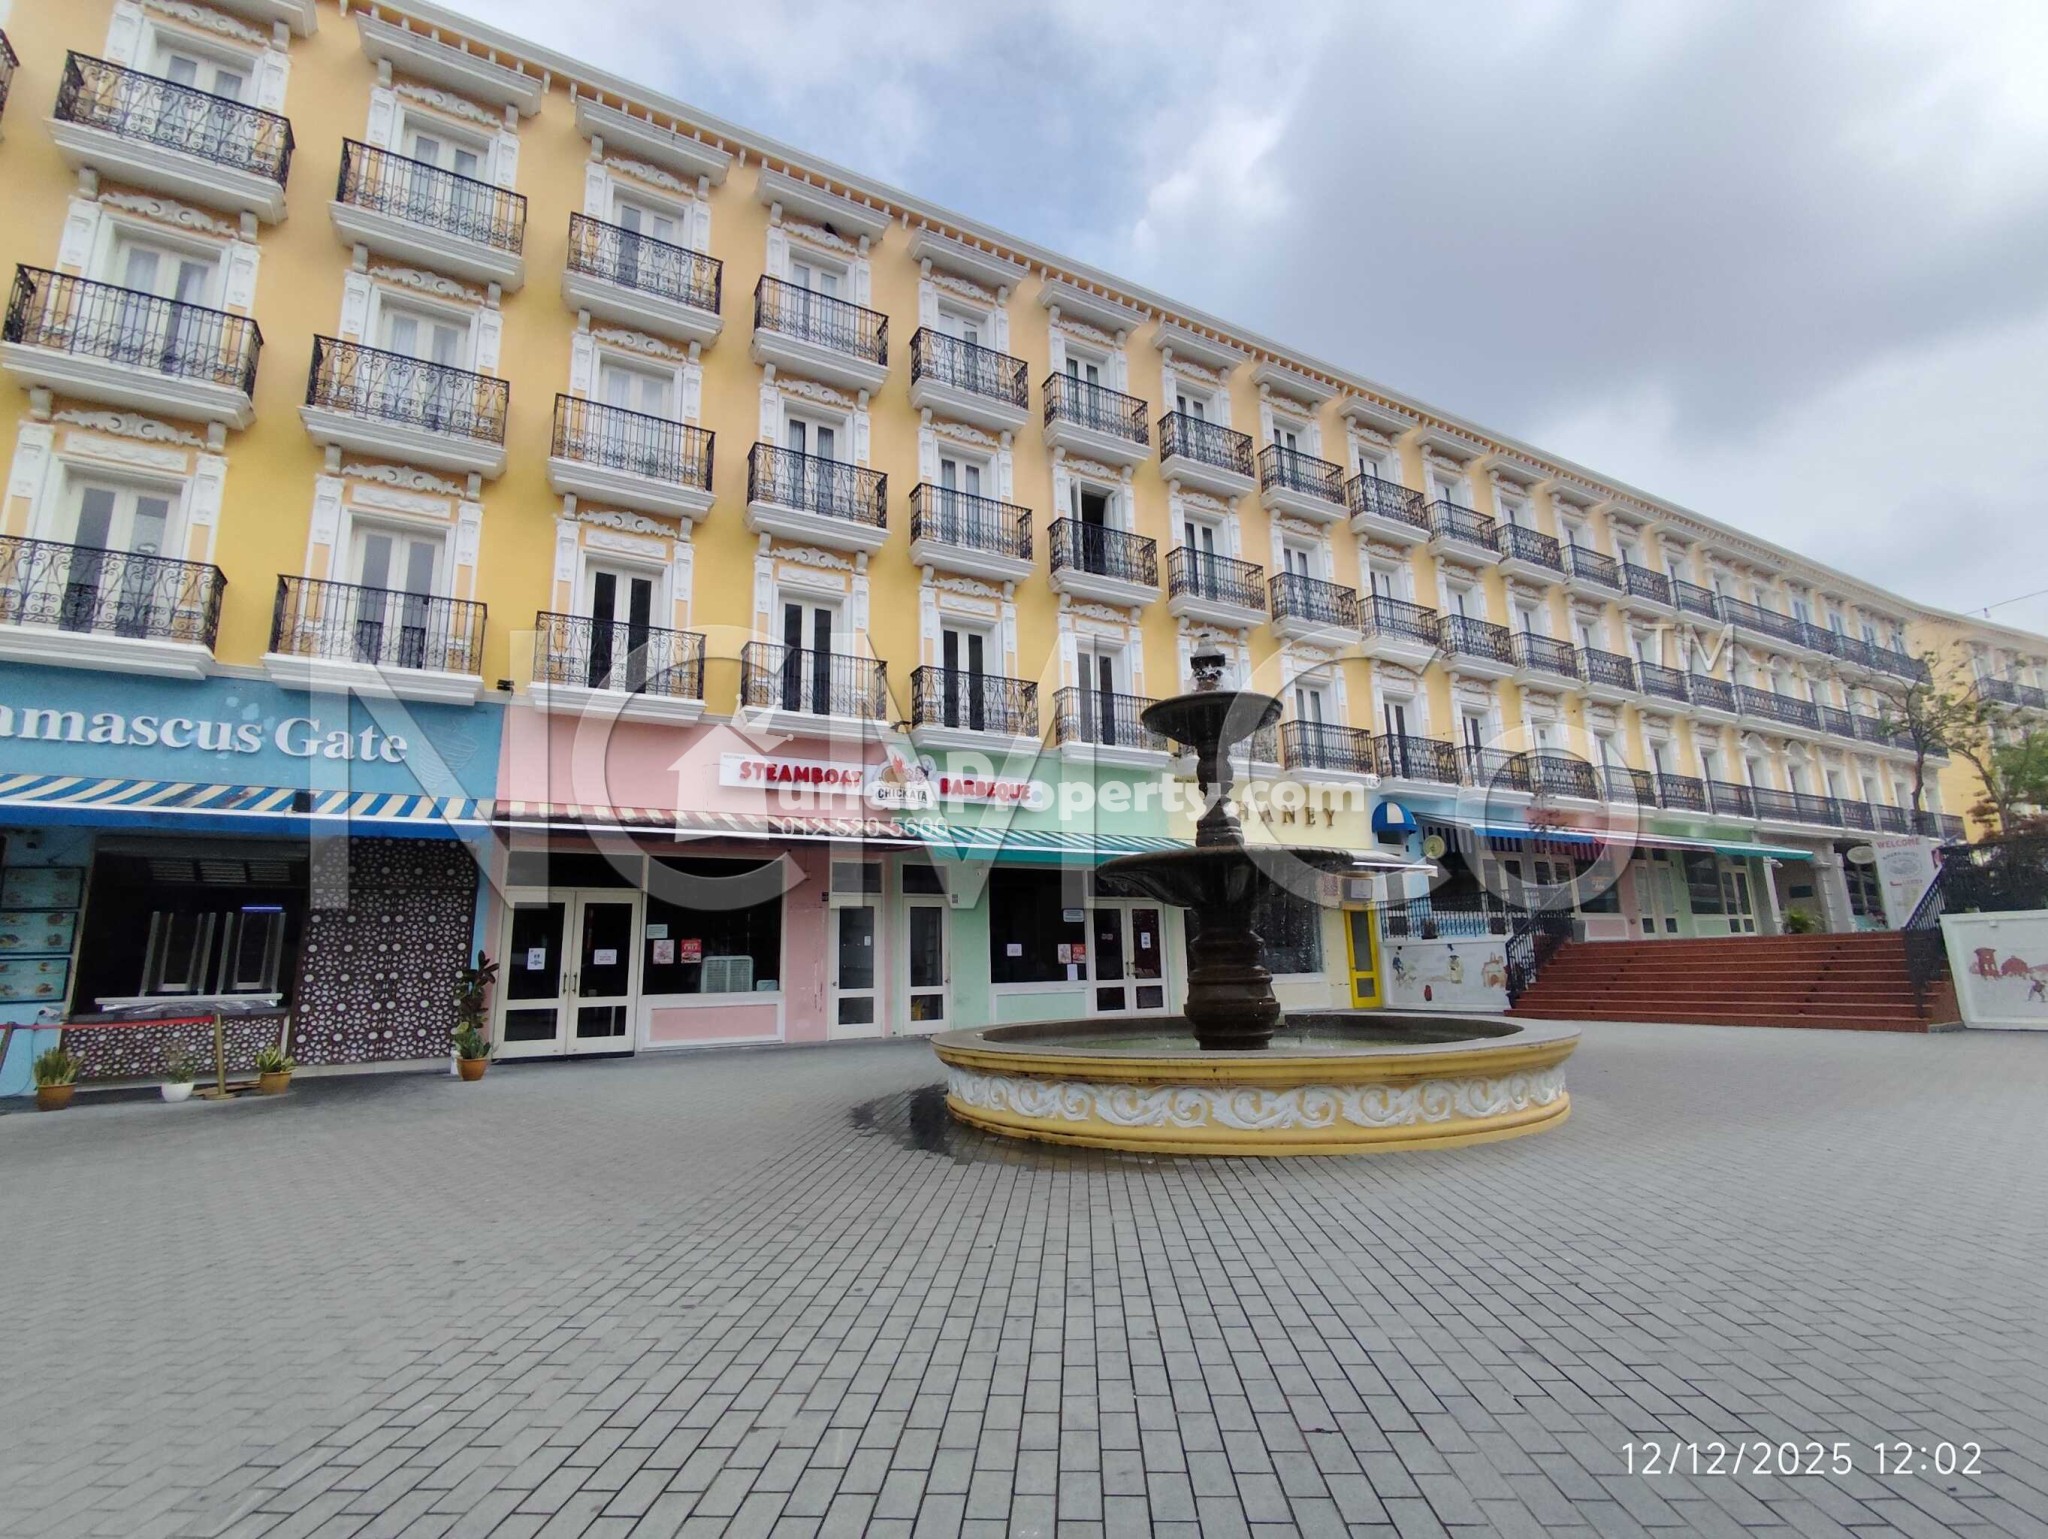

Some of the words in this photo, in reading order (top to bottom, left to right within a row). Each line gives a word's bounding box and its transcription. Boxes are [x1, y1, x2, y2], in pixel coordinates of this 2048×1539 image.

[274, 717, 408, 763] Gate
[739, 761, 864, 787] STEAMBOAT
[877, 787, 928, 803] CHICKATA
[939, 777, 1031, 801] BARBEQUE
[1877, 838, 1920, 848] WELCOME
